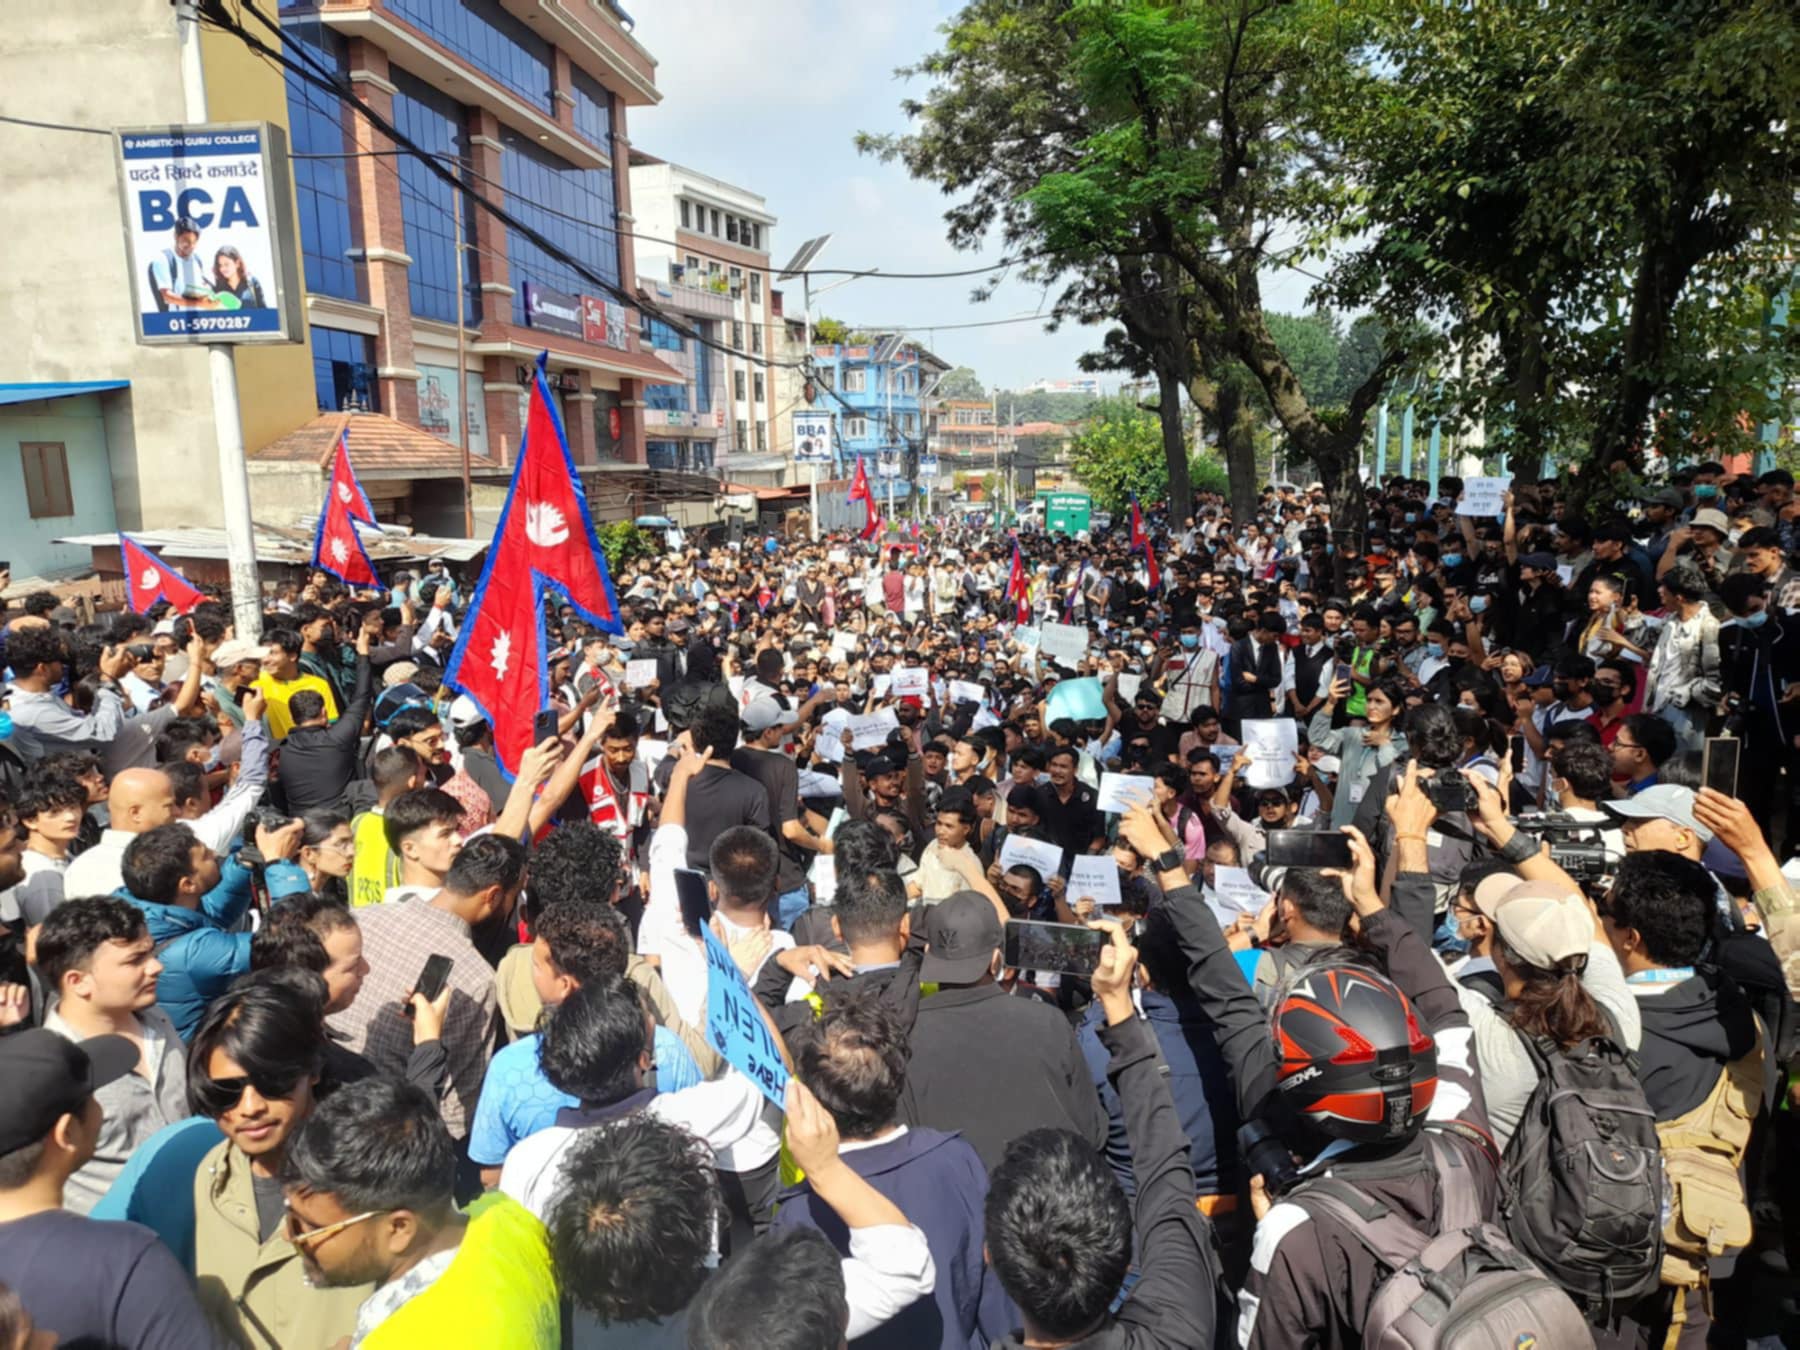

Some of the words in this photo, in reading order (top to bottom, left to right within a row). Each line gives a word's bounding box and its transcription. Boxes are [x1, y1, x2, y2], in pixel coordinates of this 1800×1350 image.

[135, 138, 183, 148] AMBITION
[184, 136, 212, 146] GURU
[214, 134, 257, 145] COLLEGE
[138, 186, 260, 232] BCA
[169, 316, 251, 332] 01-5970287
[747, 1053, 786, 1104] Have
